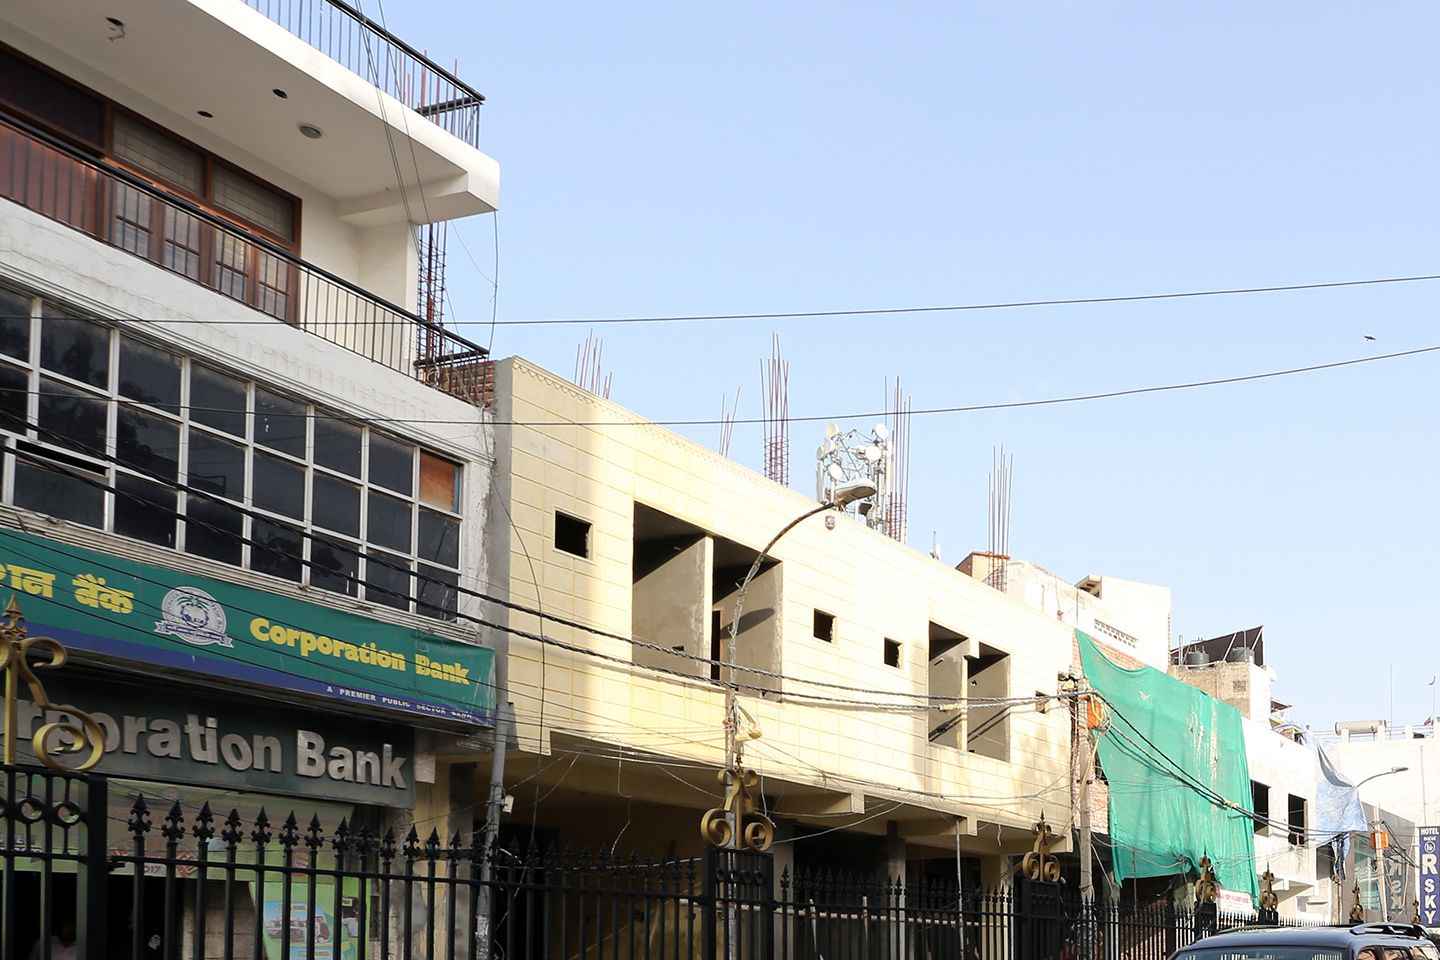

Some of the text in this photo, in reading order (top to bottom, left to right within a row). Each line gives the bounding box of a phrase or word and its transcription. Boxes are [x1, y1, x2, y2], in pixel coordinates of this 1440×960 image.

[72, 573, 135, 615] बैंक
[250, 617, 471, 686] Corporation Bank
[326, 685, 334, 694] A
[339, 688, 377, 702] PREMIER
[382, 696, 411, 708] PUBLIC
[0, 697, 408, 789] rporation Bank
[1420, 827, 1440, 836] HOTEL
